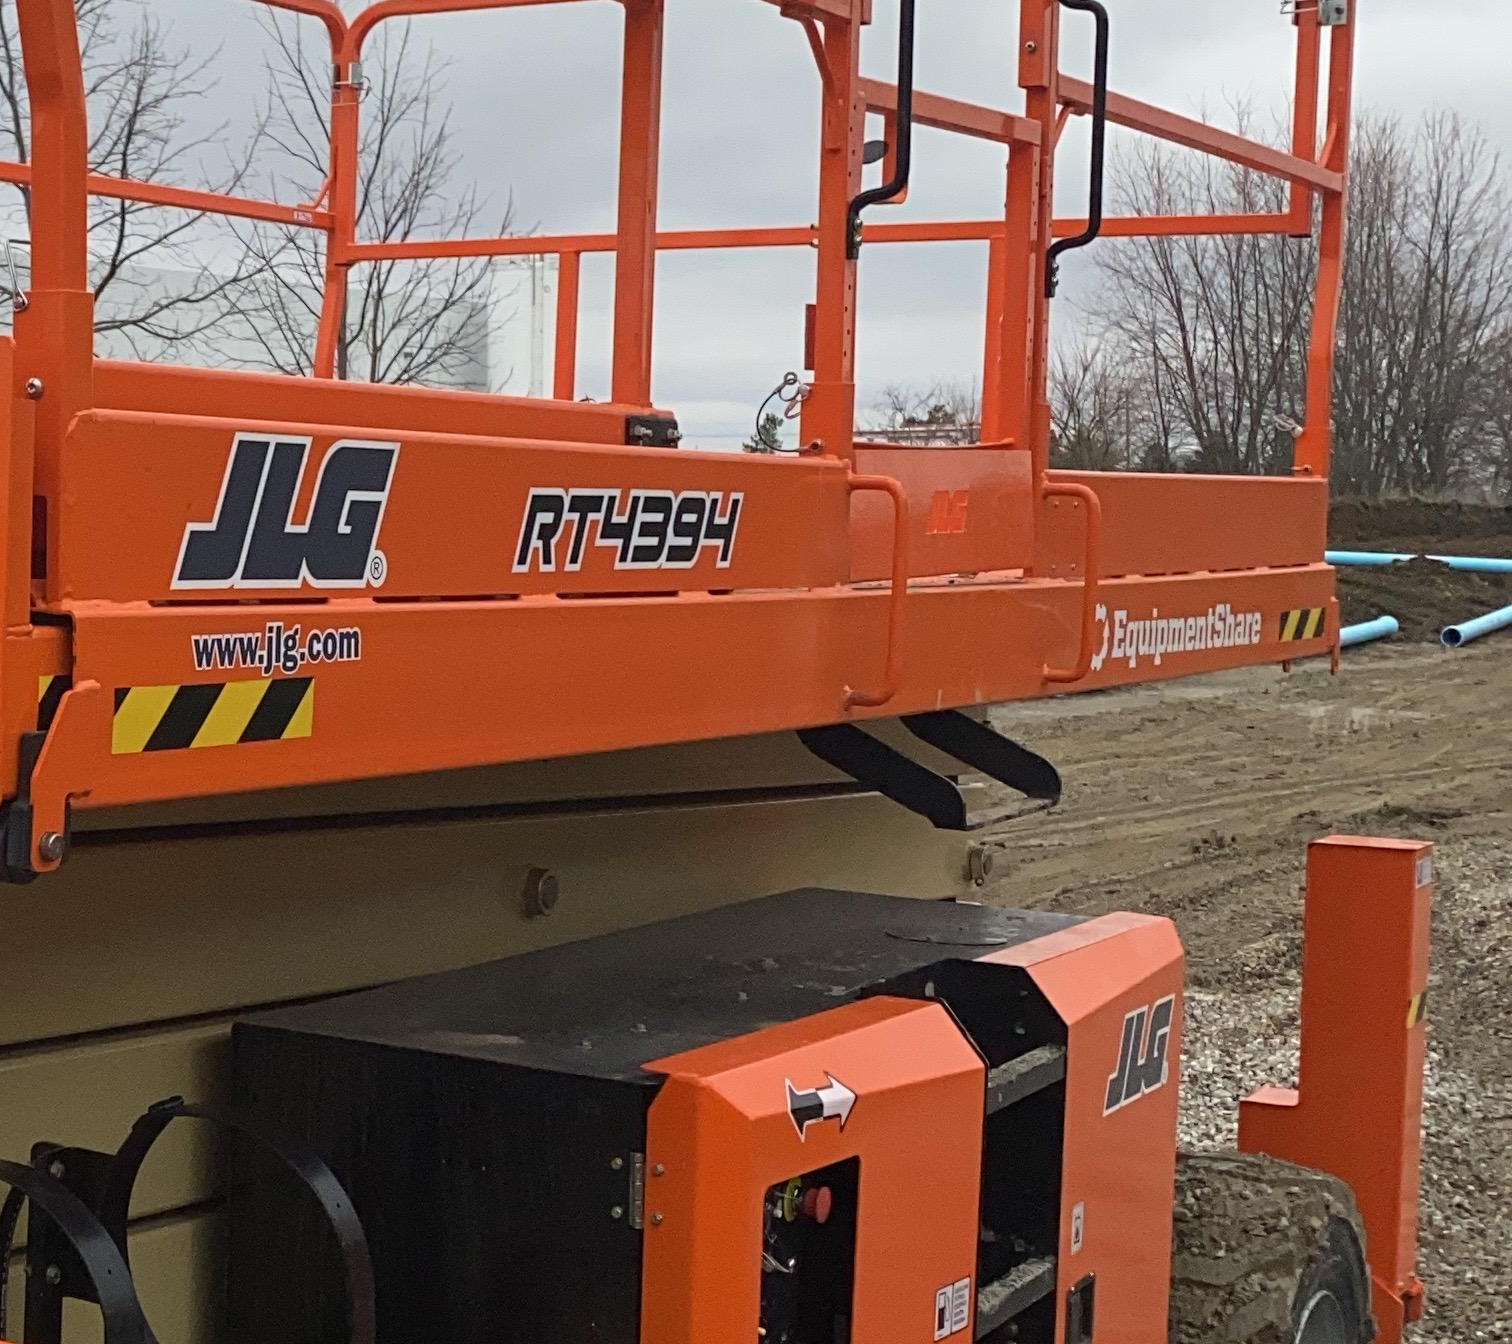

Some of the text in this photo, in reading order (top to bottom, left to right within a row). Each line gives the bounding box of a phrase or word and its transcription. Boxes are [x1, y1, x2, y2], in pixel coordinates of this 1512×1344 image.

[512, 486, 743, 573] RT4394
[191, 621, 361, 677] www.jlg.com
[1112, 603, 1261, 669] EquipmentShare
